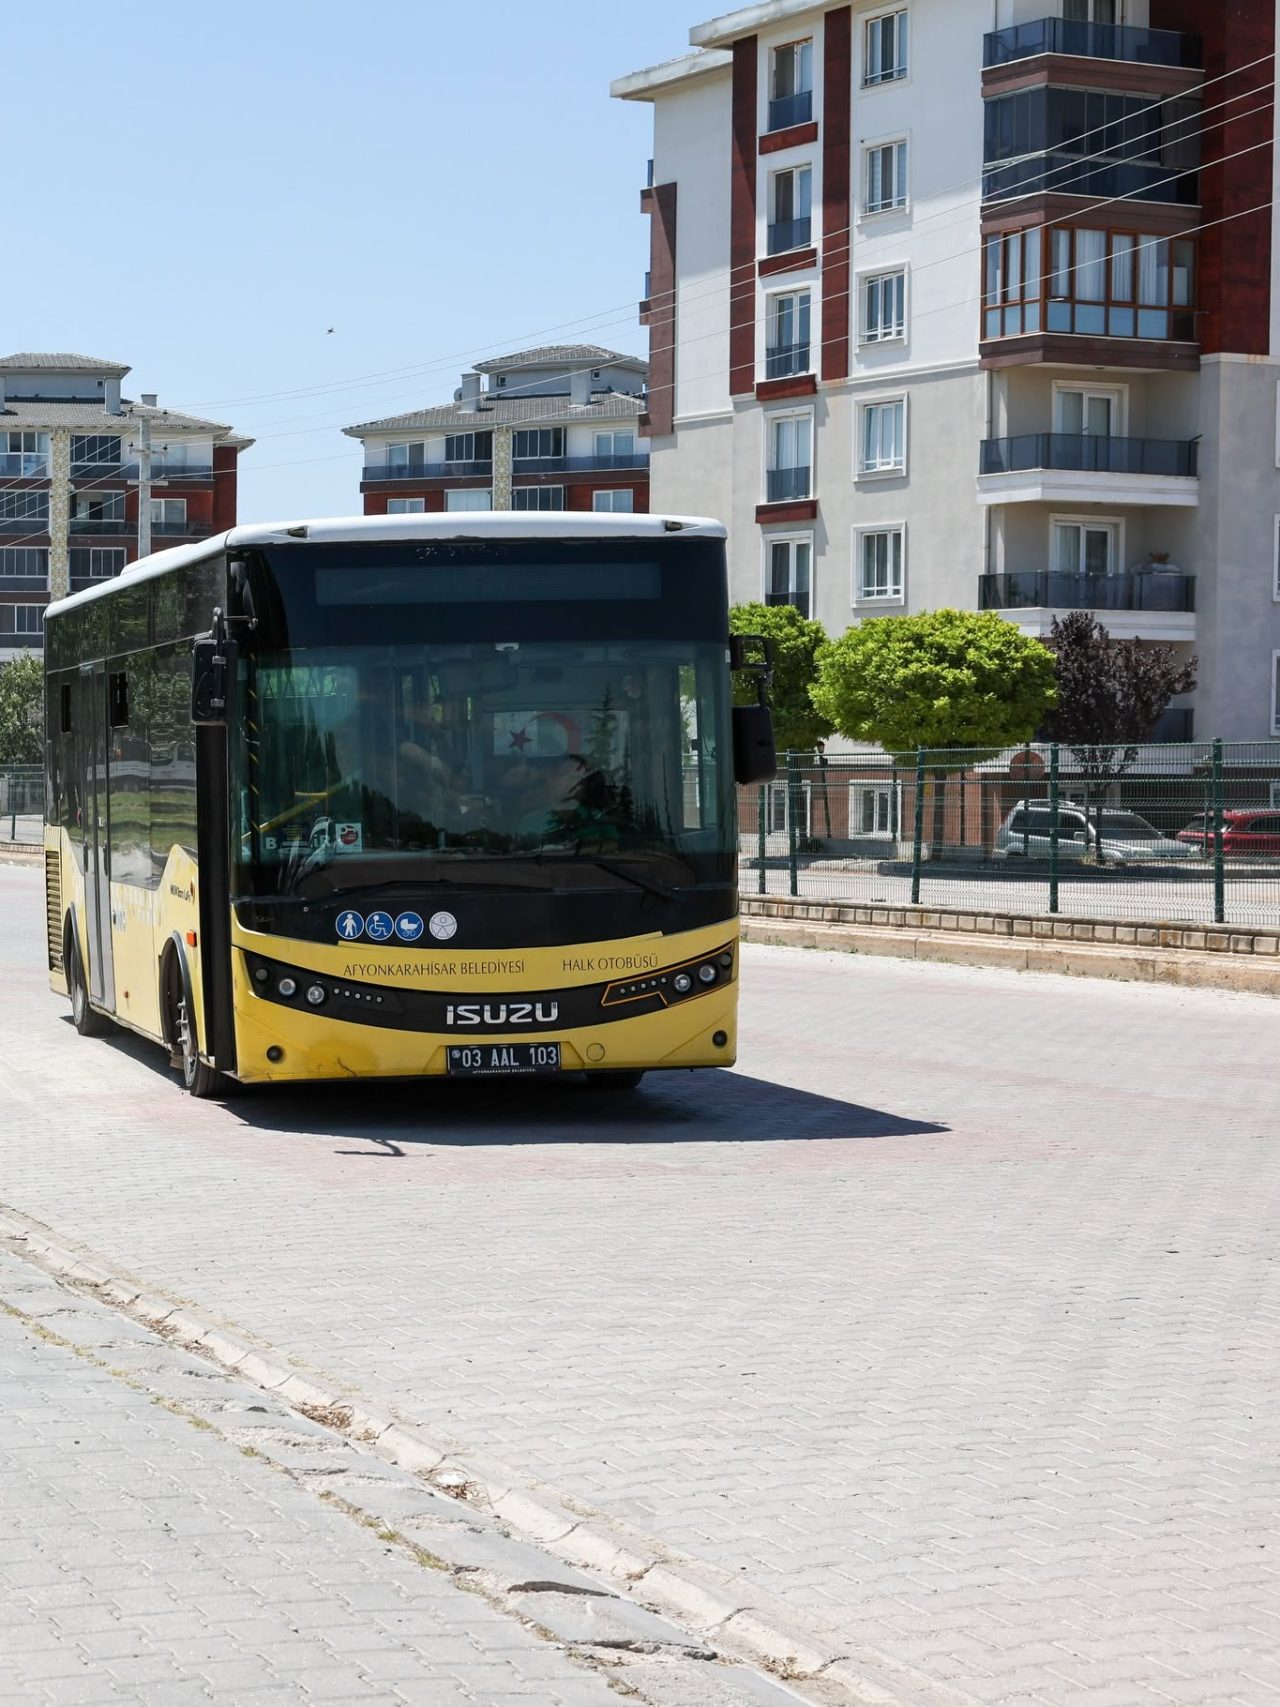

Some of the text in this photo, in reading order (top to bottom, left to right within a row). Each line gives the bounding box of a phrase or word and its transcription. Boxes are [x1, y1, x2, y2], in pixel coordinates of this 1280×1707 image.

[343, 958, 525, 976] AFYONKARAHİSAR BELEDİYESİ
[562, 953, 659, 972] HALK OTOBÜSÜ
[446, 1001, 558, 1025] ISUZU
[462, 1046, 557, 1067] 03 AAL 103
